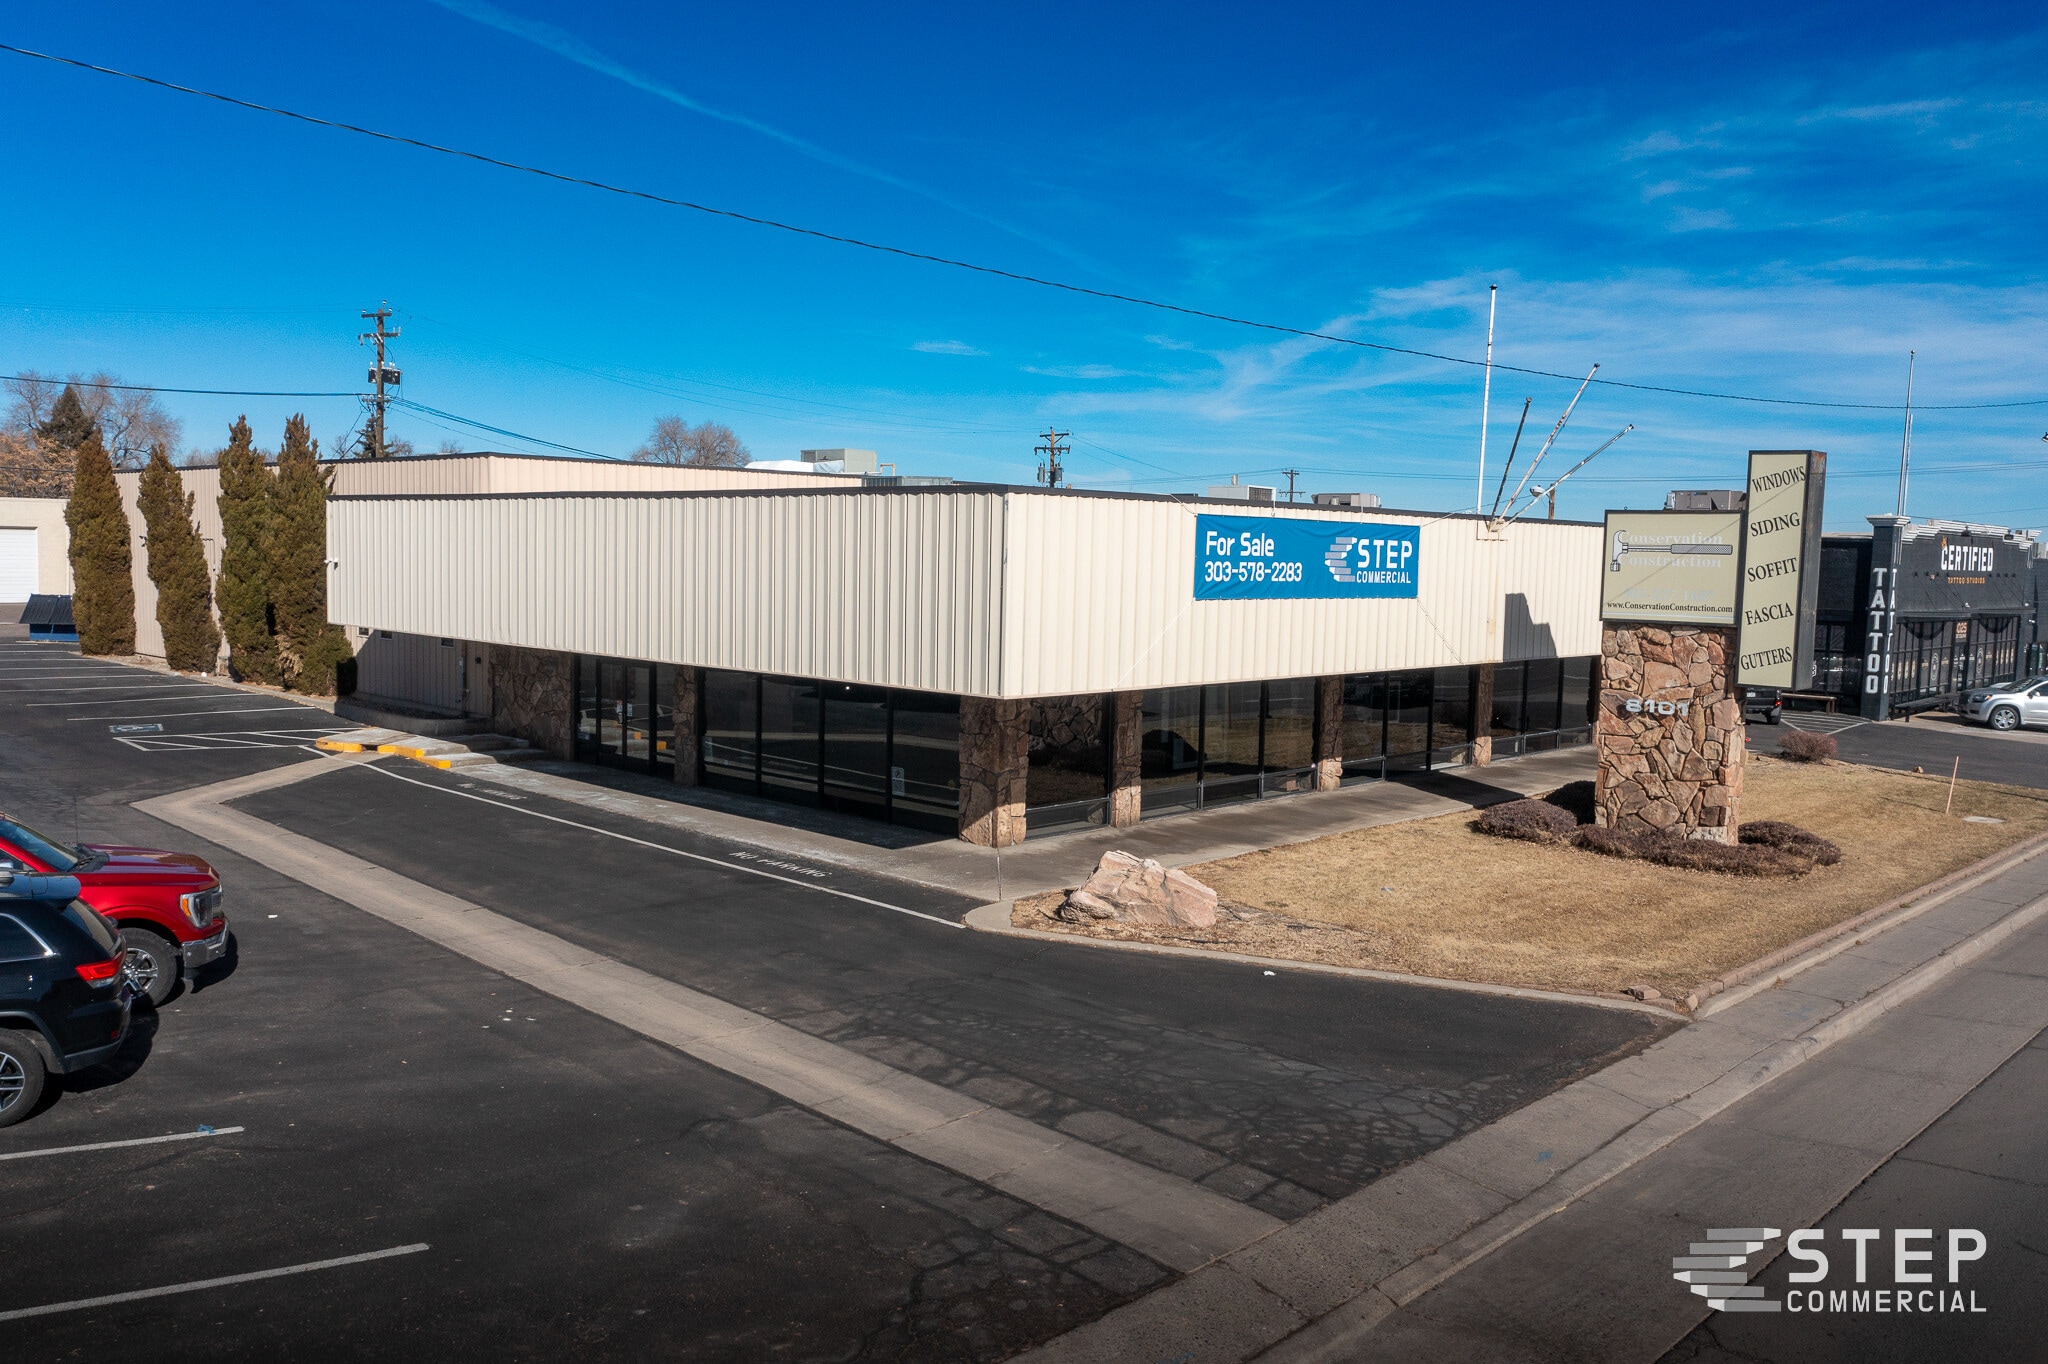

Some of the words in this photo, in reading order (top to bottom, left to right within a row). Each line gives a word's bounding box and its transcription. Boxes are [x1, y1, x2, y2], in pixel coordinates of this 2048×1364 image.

[1752, 466, 1806, 493] WINDOWS
[1750, 512, 1800, 537] SIDING
[1206, 531, 1235, 556] For
[1240, 532, 1275, 557] Sale
[1357, 539, 1413, 569] STEP
[1747, 557, 1798, 582] SOFFIT
[1941, 545, 1993, 571] CERTIFIED
[1205, 561, 1303, 582] 303-578-2283
[1356, 571, 1412, 584] COMMERCIAL
[1606, 601, 1733, 613] www.ConservationConstruction.com
[1745, 602, 1794, 625] FASCIA
[1865, 568, 1888, 694] TATTOO
[1740, 646, 1793, 671] GUTTERS
[1625, 698, 1688, 716] 8101
